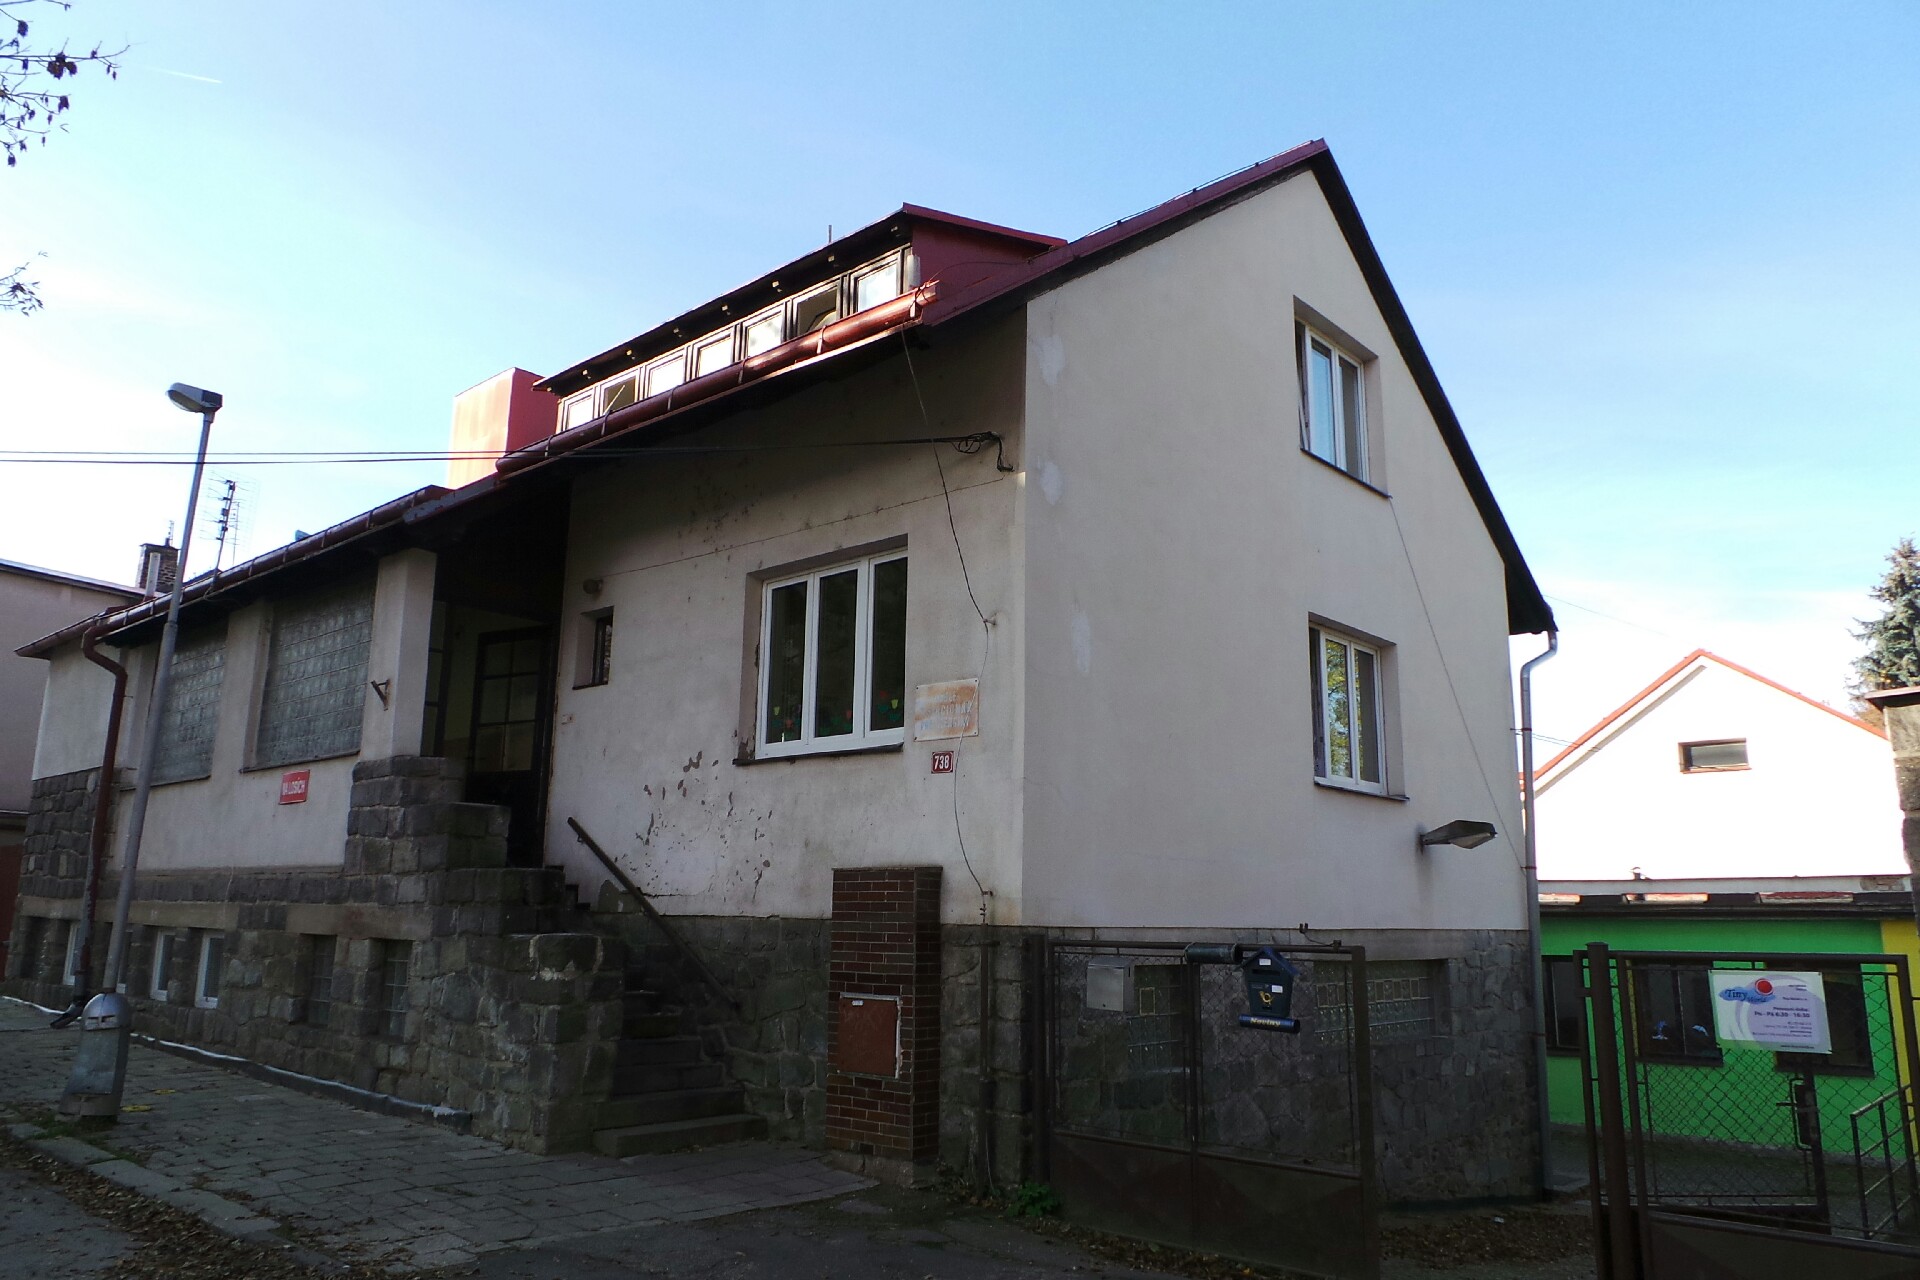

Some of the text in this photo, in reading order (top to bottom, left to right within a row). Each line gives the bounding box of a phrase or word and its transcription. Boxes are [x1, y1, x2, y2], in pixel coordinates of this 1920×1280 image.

[934, 755, 950, 770] 738
[1725, 989, 1748, 1002] Tiny
[1250, 1017, 1281, 1027] Noviny
